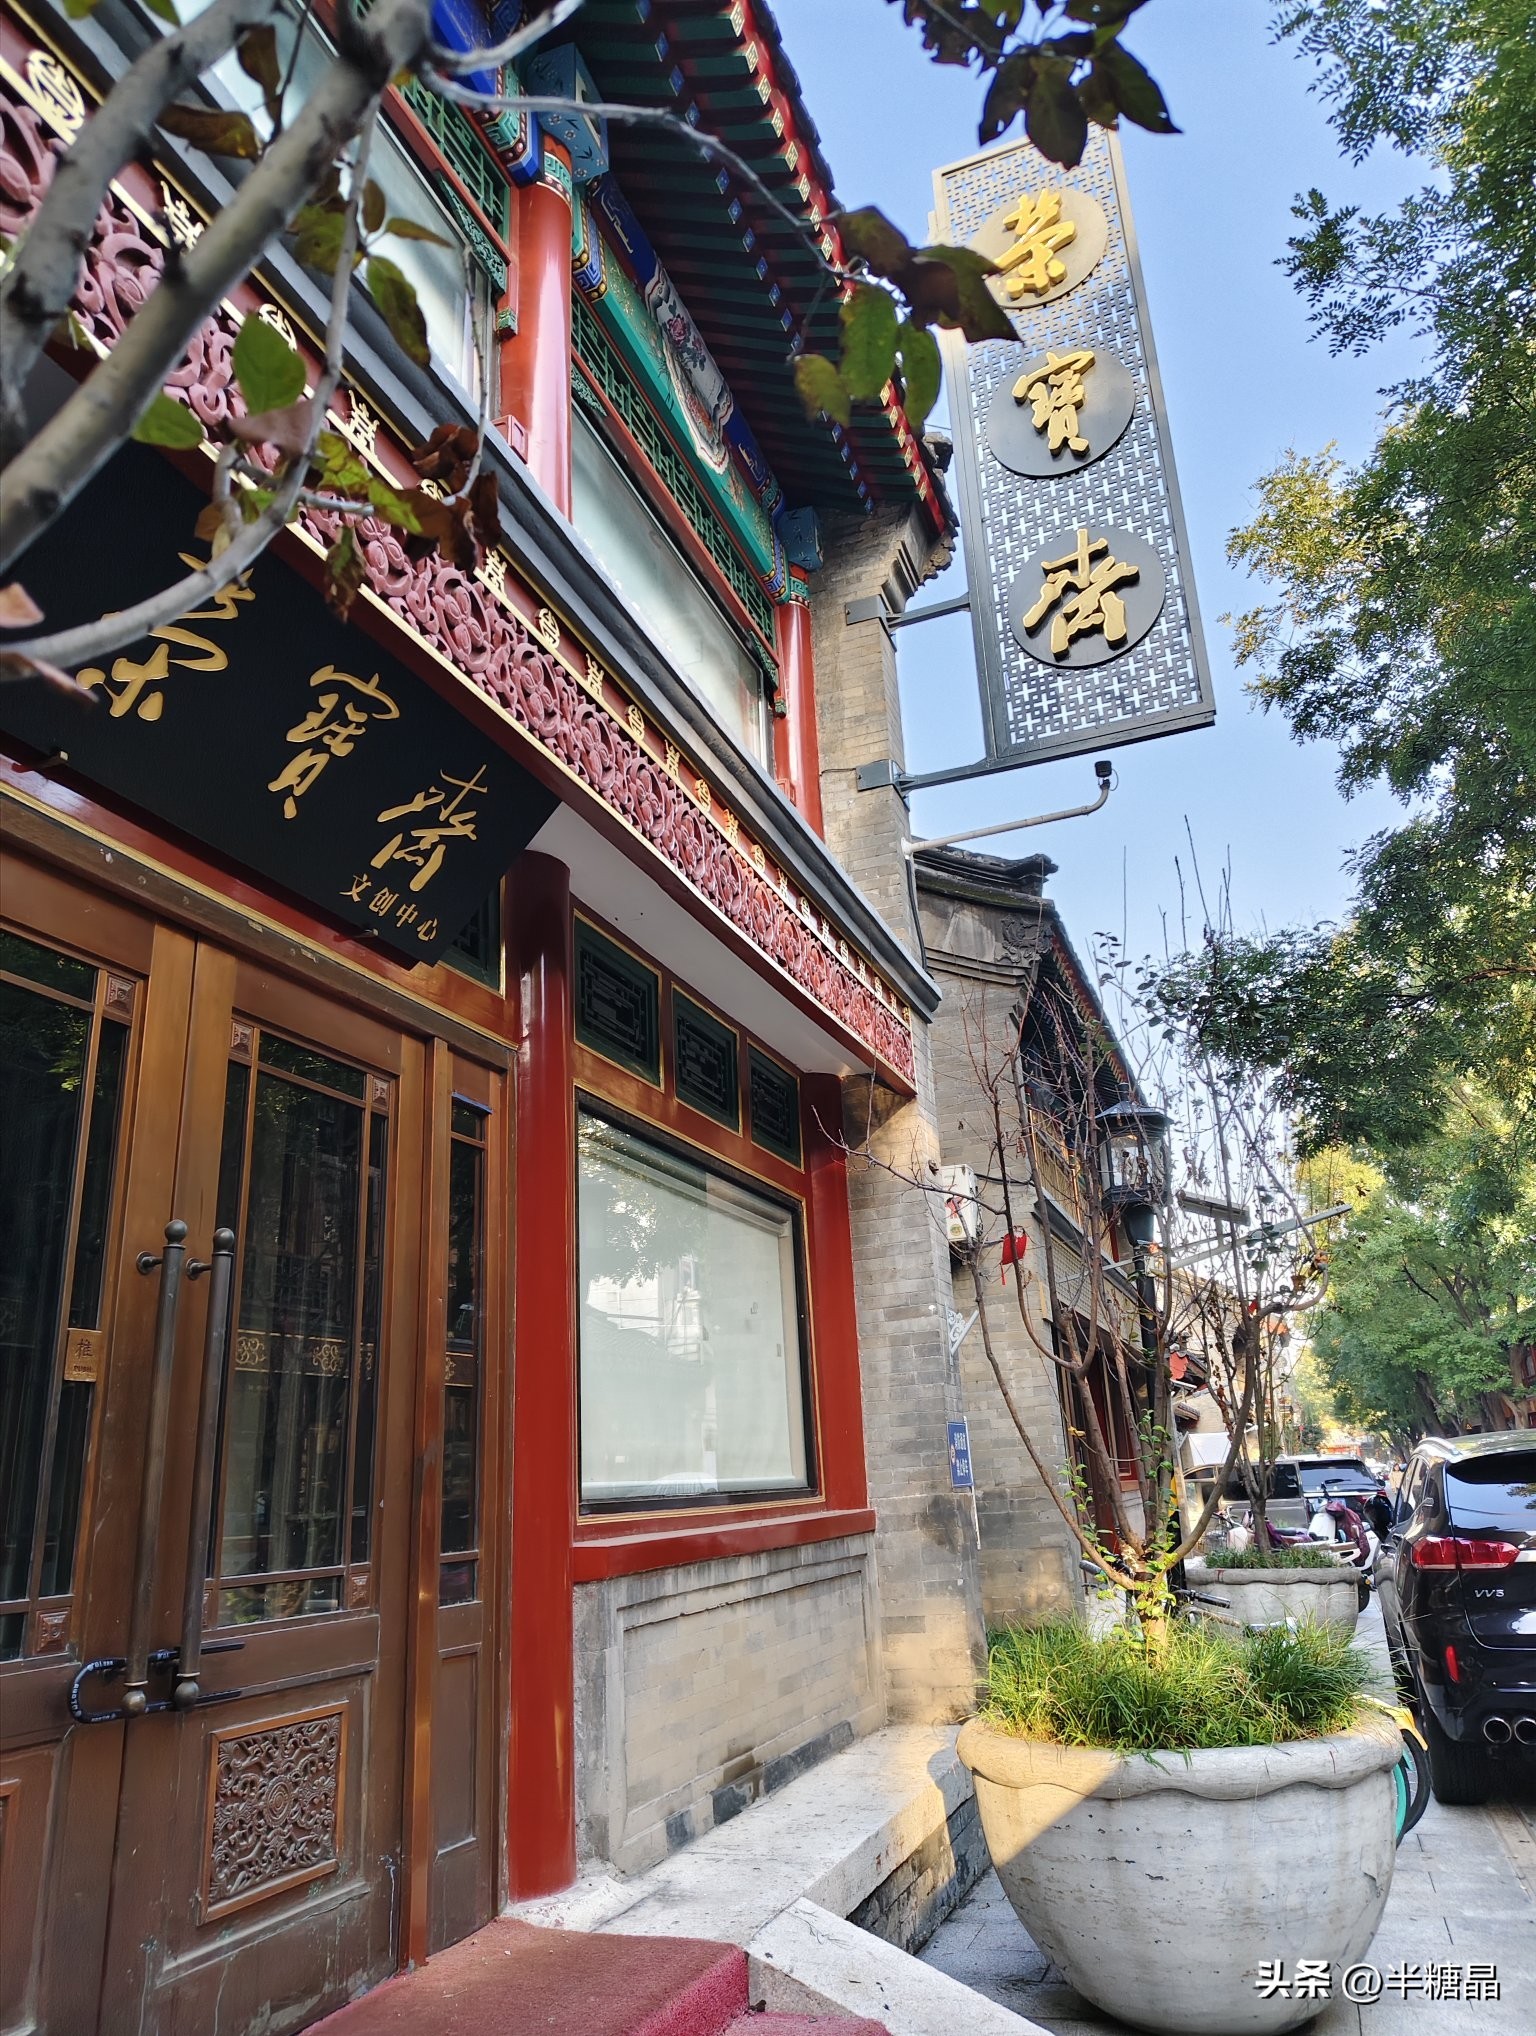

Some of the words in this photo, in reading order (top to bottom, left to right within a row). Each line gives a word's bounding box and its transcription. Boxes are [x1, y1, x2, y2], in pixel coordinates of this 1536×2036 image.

[340, 873, 438, 941] 文创中心
[75, 1339, 93, 1360] 推
[1474, 1589, 1505, 1598] VV5
